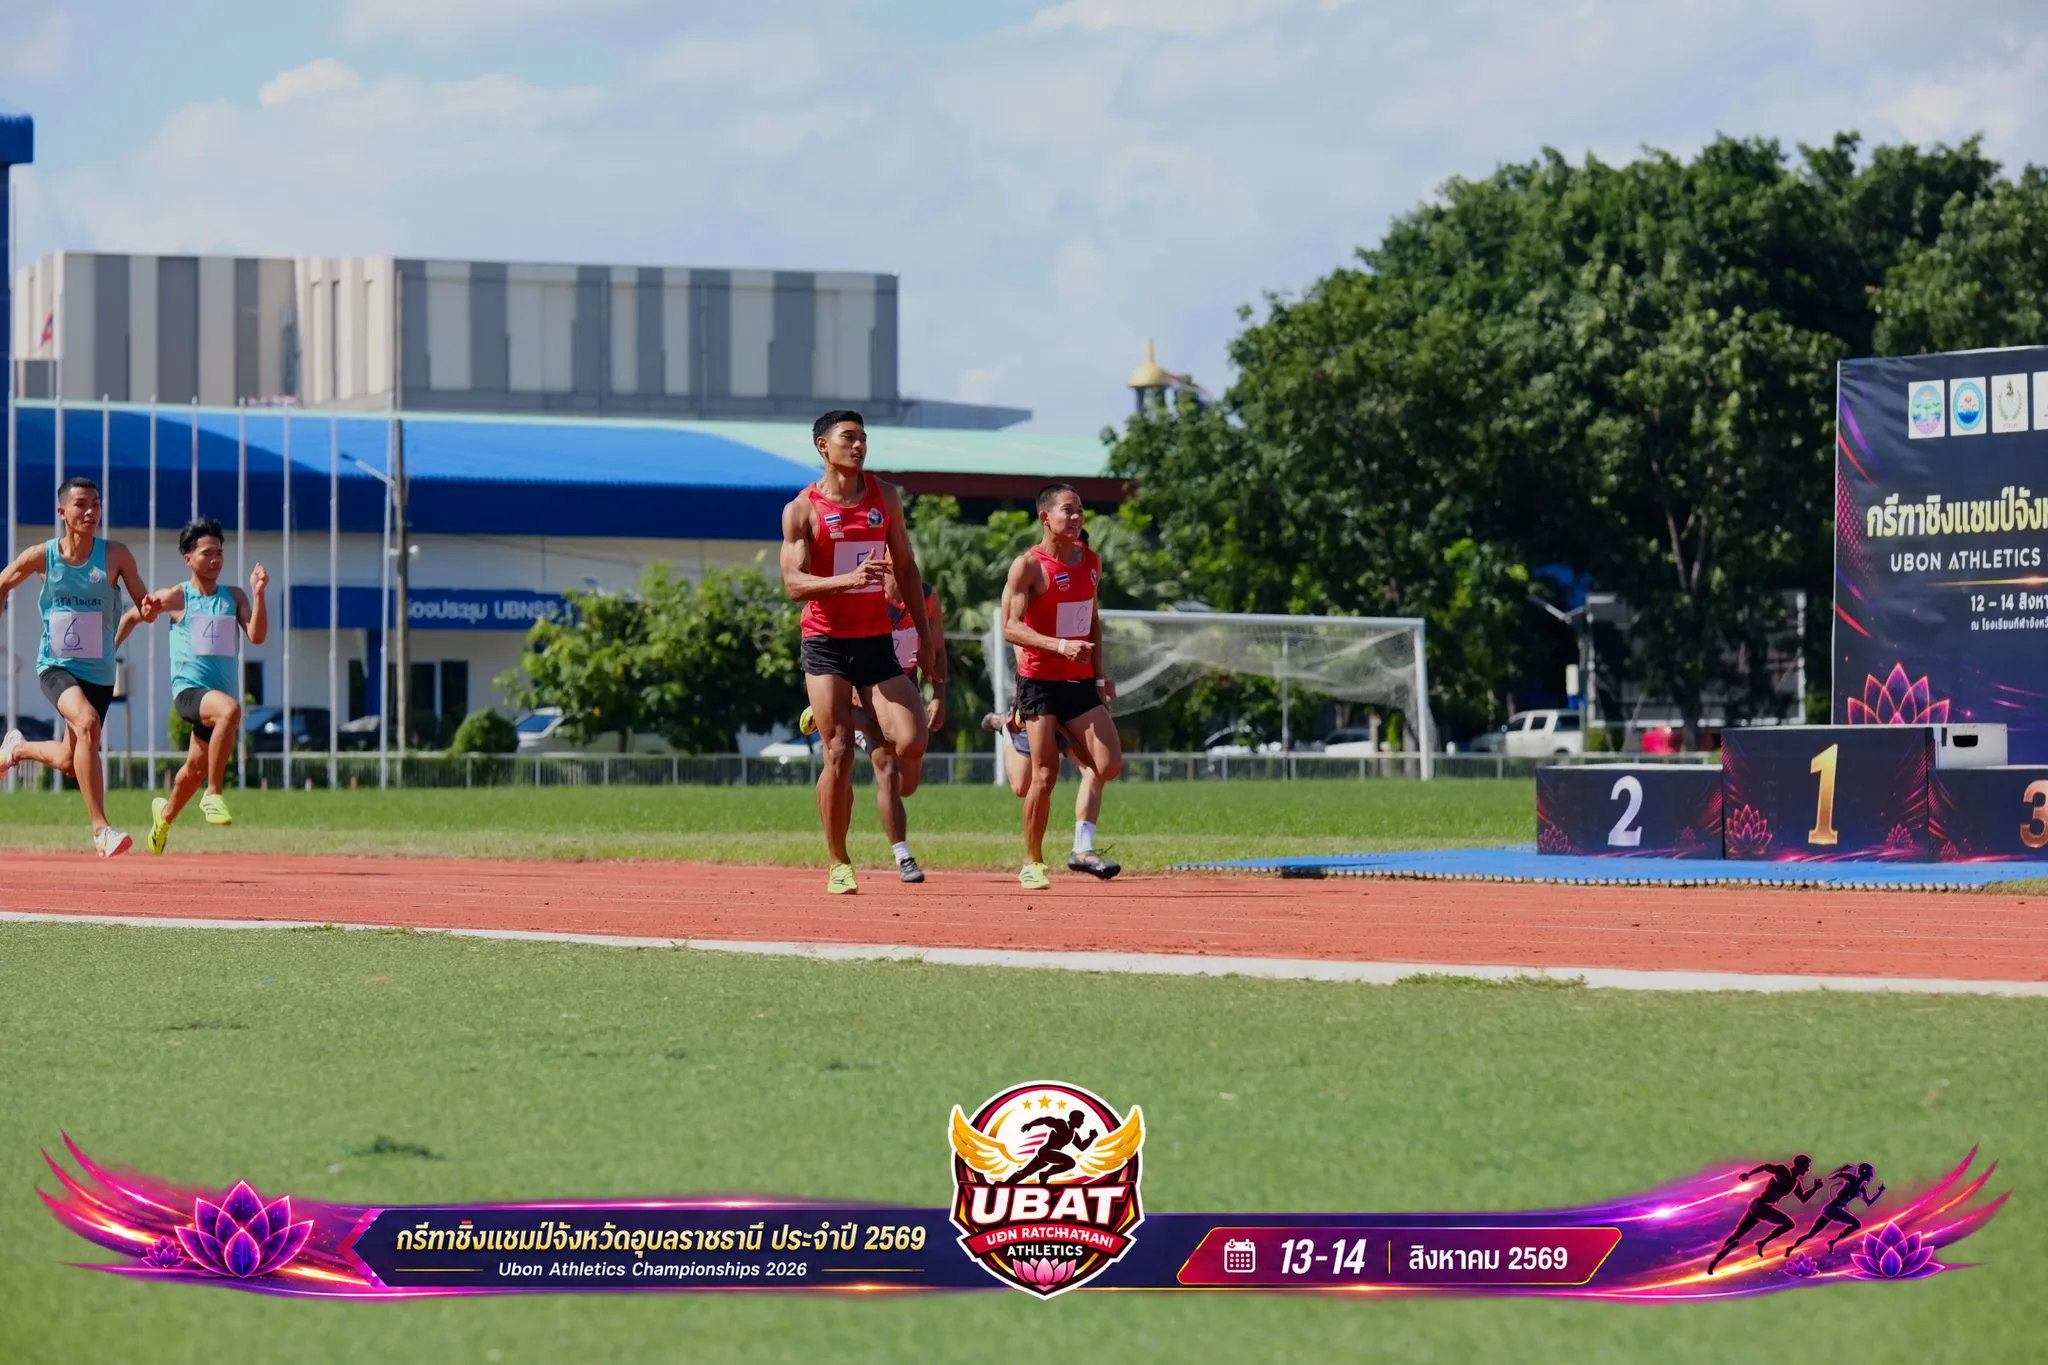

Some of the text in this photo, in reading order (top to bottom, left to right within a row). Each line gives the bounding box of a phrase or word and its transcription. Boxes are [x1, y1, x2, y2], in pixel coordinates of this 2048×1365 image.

[1890, 547, 2041, 573] UBON ATHLETICS
[1971, 594, 1985, 612] 12
[2001, 593, 2014, 611] 14
[63, 617, 81, 649] 6
[202, 620, 220, 645] 4
[1808, 743, 1838, 845] 1
[1607, 775, 1643, 846] 2
[2020, 779, 2048, 848] 3
